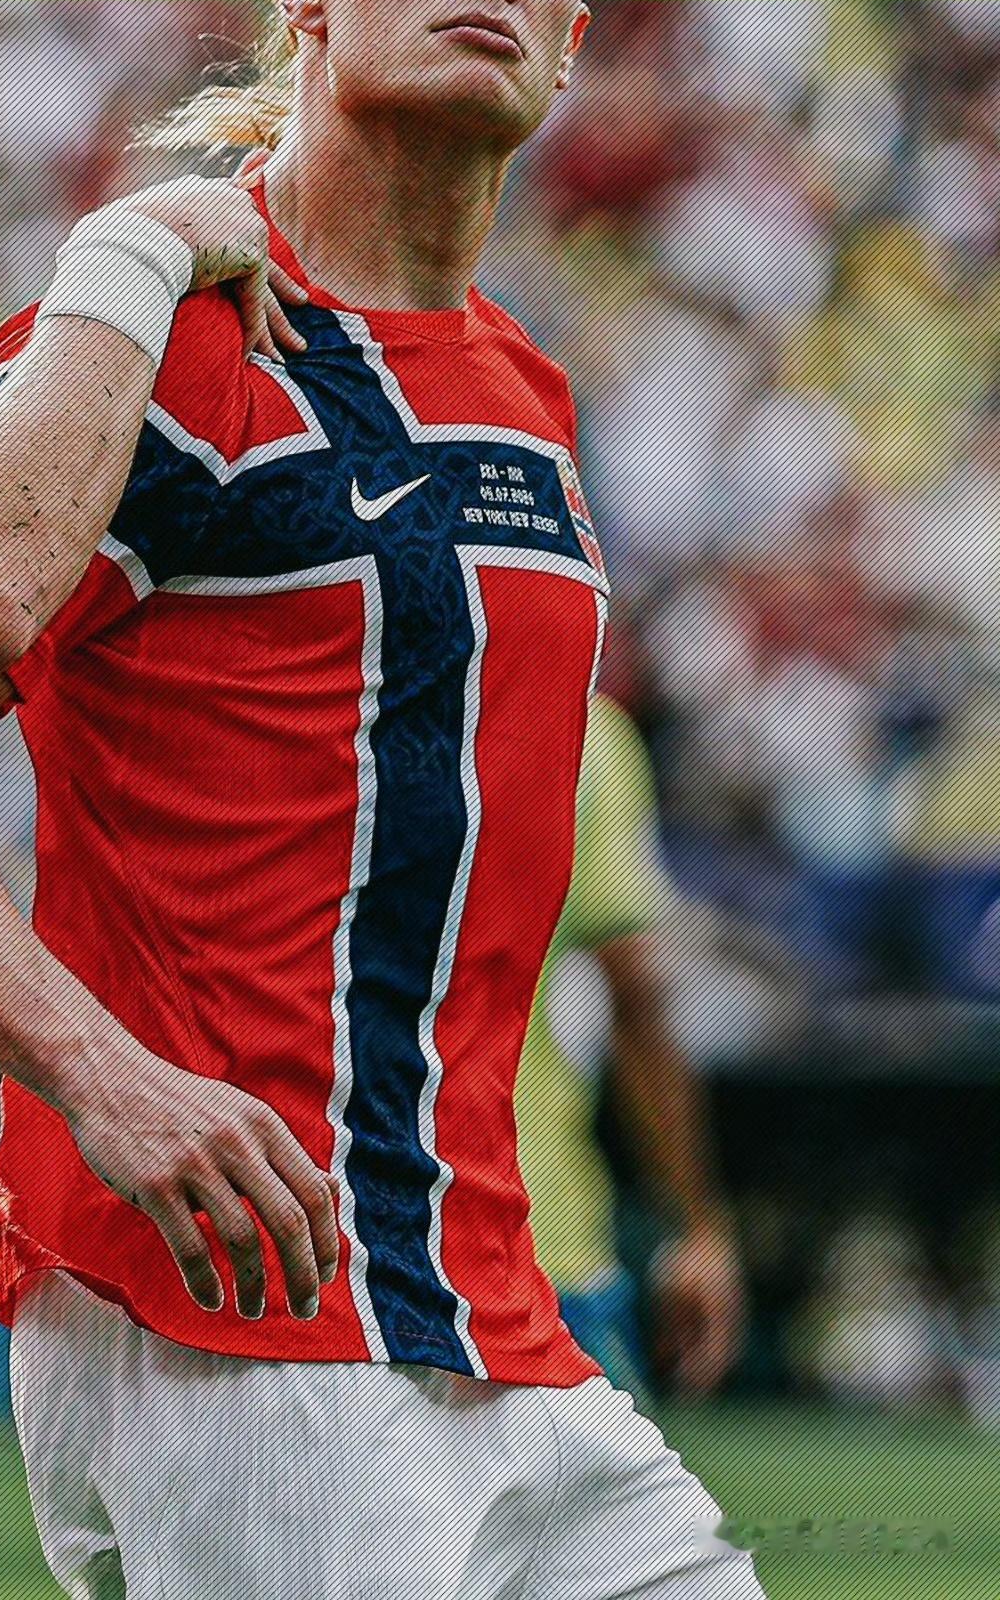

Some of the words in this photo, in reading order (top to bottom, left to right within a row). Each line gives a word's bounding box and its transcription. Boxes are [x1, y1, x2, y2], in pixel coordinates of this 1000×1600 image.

[462, 507, 484, 524] NEW
[483, 508, 510, 527] YORK
[509, 511, 530, 528] NEW
